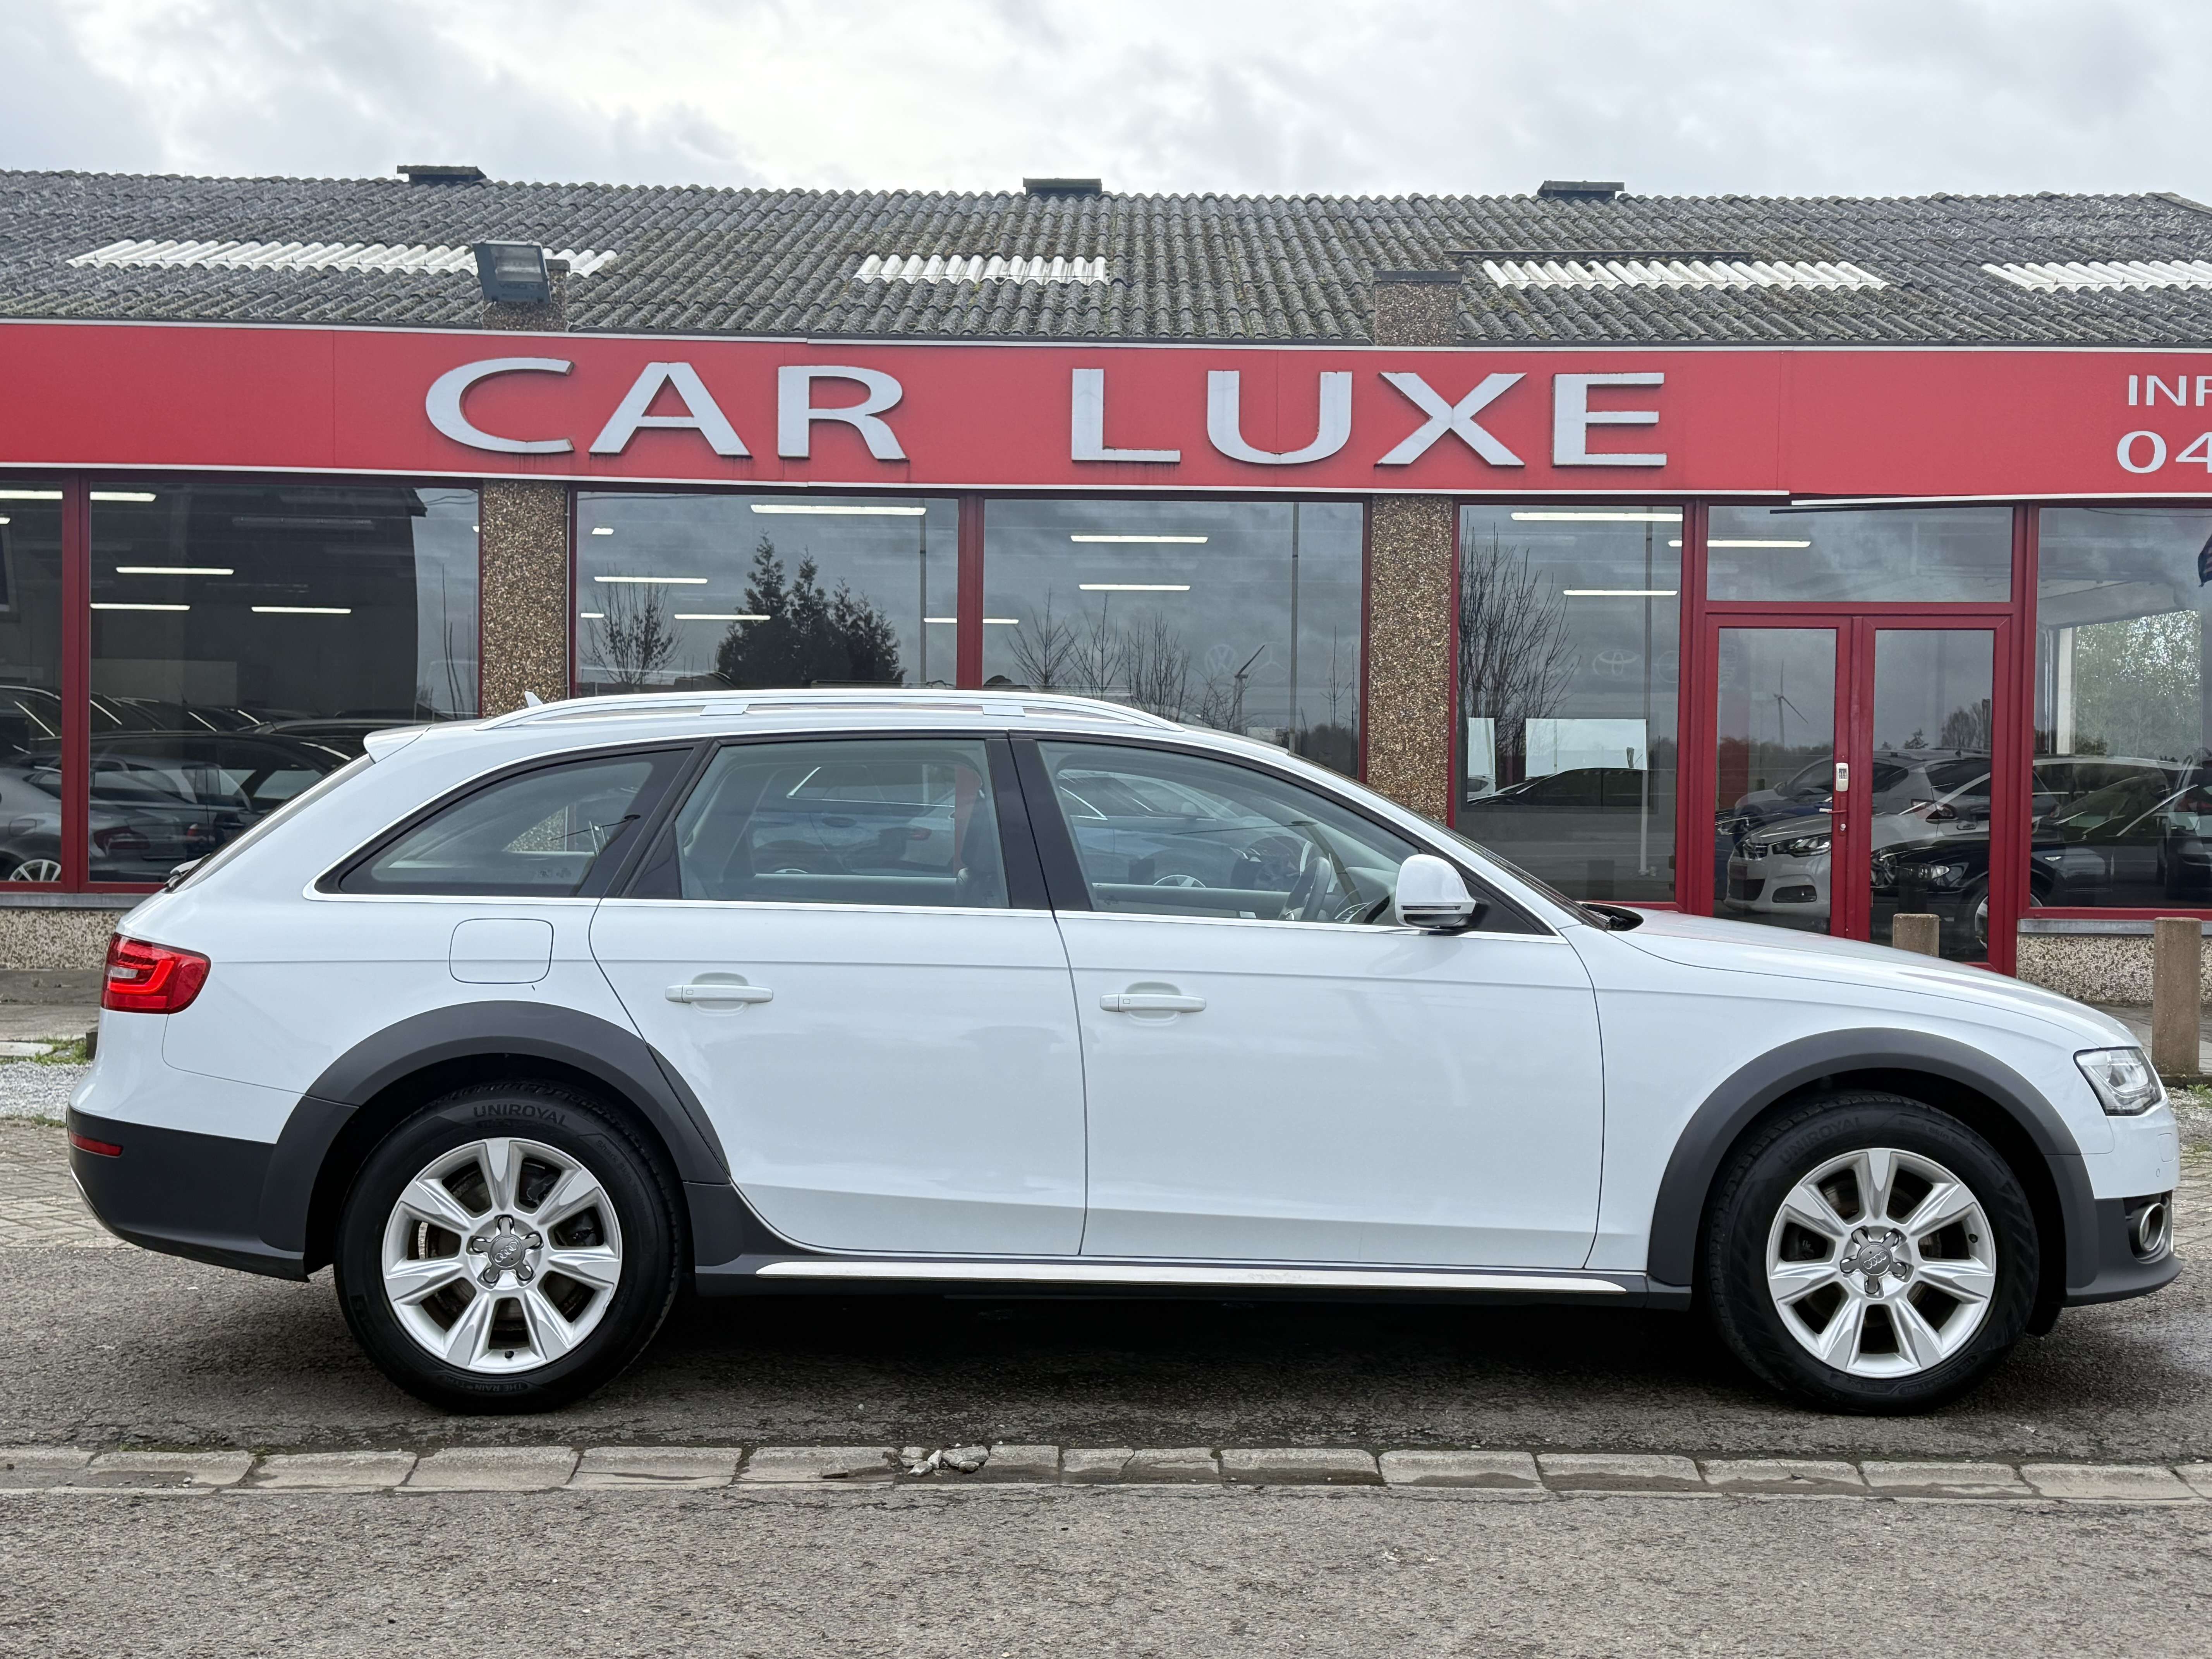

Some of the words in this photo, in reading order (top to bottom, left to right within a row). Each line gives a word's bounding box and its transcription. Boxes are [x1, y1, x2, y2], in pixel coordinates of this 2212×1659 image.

[425, 357, 908, 461] CAR
[1071, 368, 1668, 466] LUXE
[473, 1104, 567, 1127] UNIROYAL
